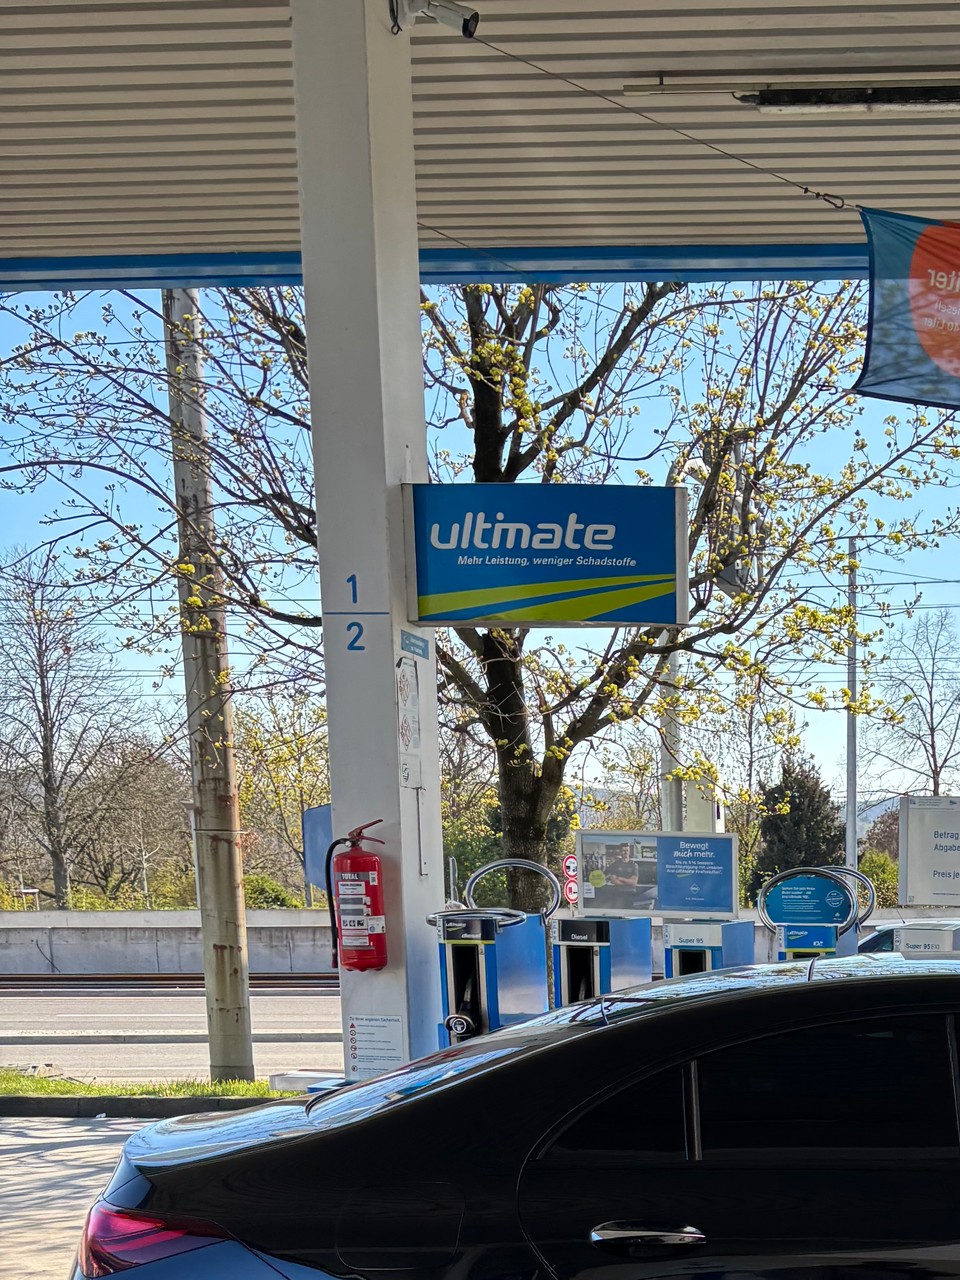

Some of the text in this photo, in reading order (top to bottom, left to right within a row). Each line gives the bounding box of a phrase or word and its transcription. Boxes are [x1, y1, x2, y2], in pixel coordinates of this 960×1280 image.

[430, 511, 616, 550] ultimate
[457, 555, 637, 568] Mehr Leistung, weniger Schadstoffe
[346, 573, 358, 604] 1
[346, 621, 366, 651] 2
[933, 830, 959, 840] Betrag
[679, 841, 709, 851] Bewegt
[673, 849, 693, 858] mich
[933, 870, 951, 878] Preis
[952, 871, 960, 880] je
